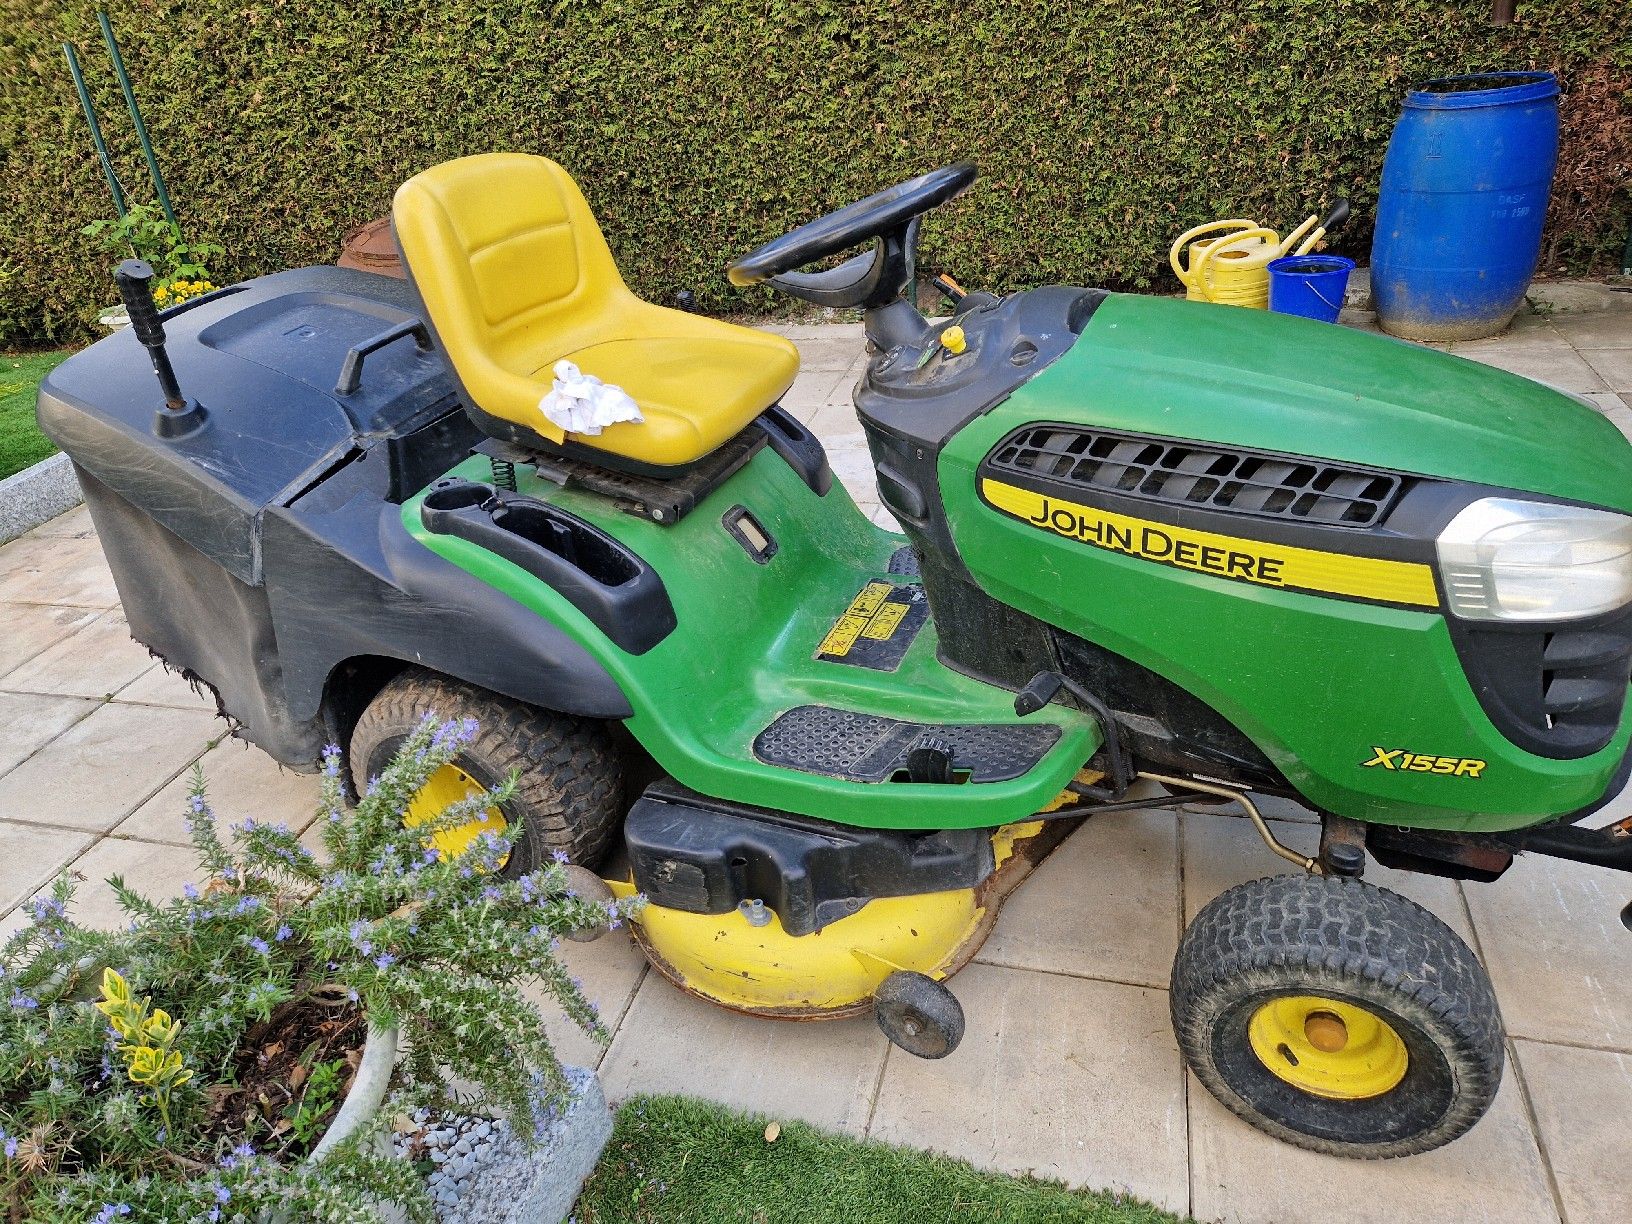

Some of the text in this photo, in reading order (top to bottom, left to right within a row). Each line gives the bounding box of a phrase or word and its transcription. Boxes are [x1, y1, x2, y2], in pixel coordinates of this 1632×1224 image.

[1030, 498, 1285, 583] JOHN DEERE
[1361, 746, 1487, 778] X155R
